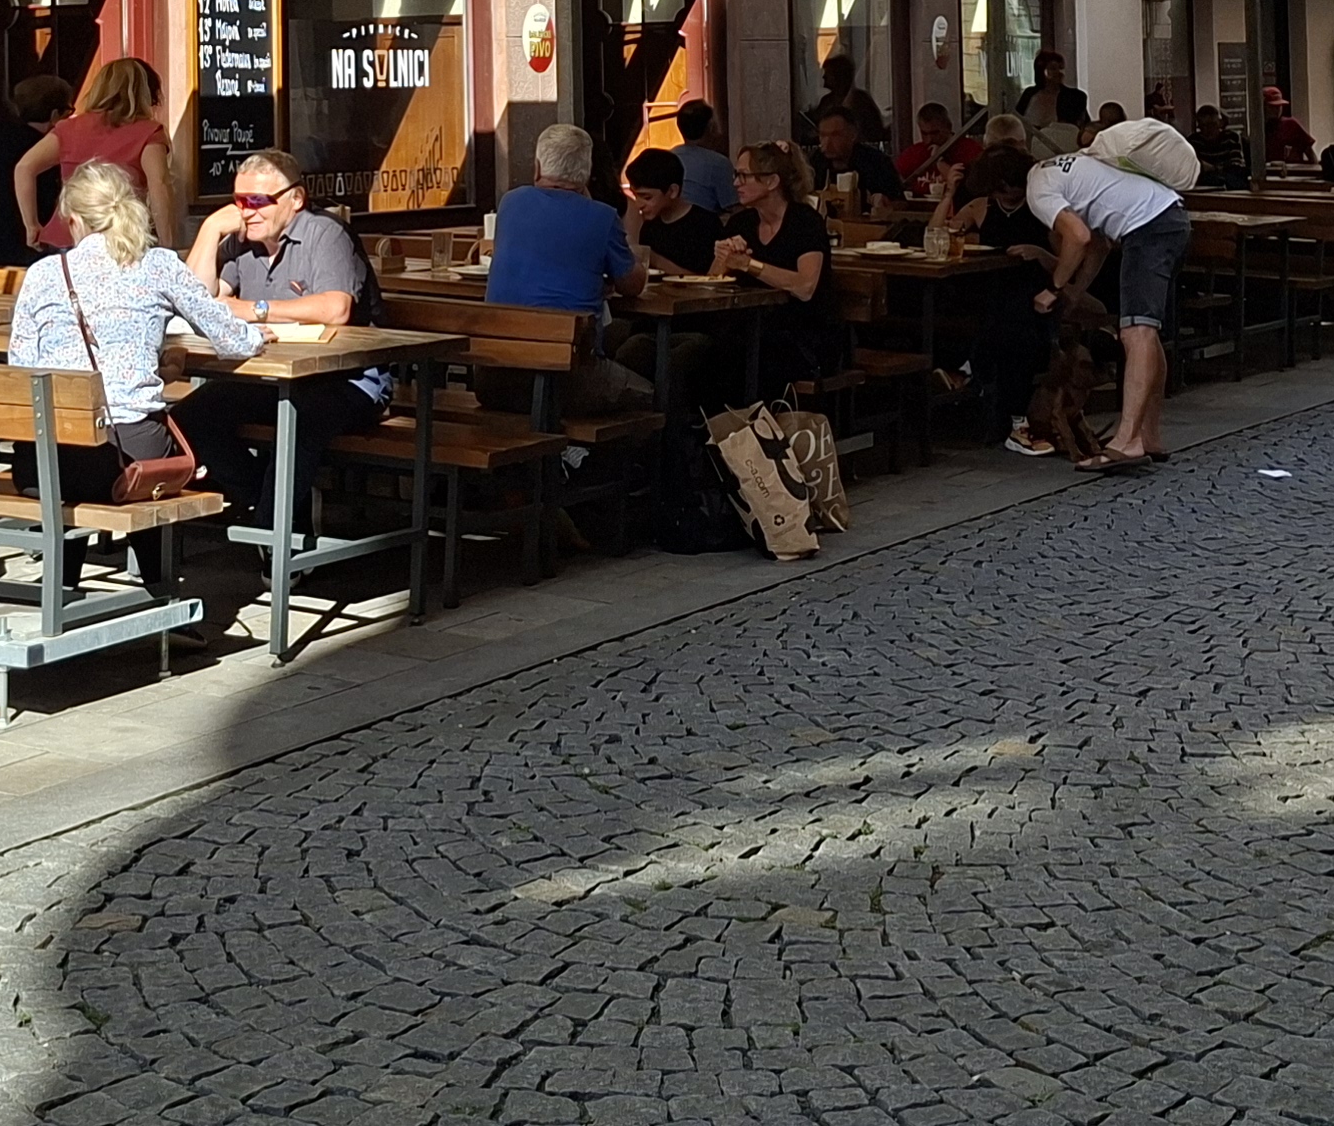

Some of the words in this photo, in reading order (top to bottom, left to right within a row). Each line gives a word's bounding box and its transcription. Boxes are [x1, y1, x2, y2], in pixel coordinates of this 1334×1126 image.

[529, 39, 551, 58] PIVO
[331, 49, 356, 89] NA
[362, 49, 430, 89] SOLNICI
[744, 458, 771, 499] c-a.com
